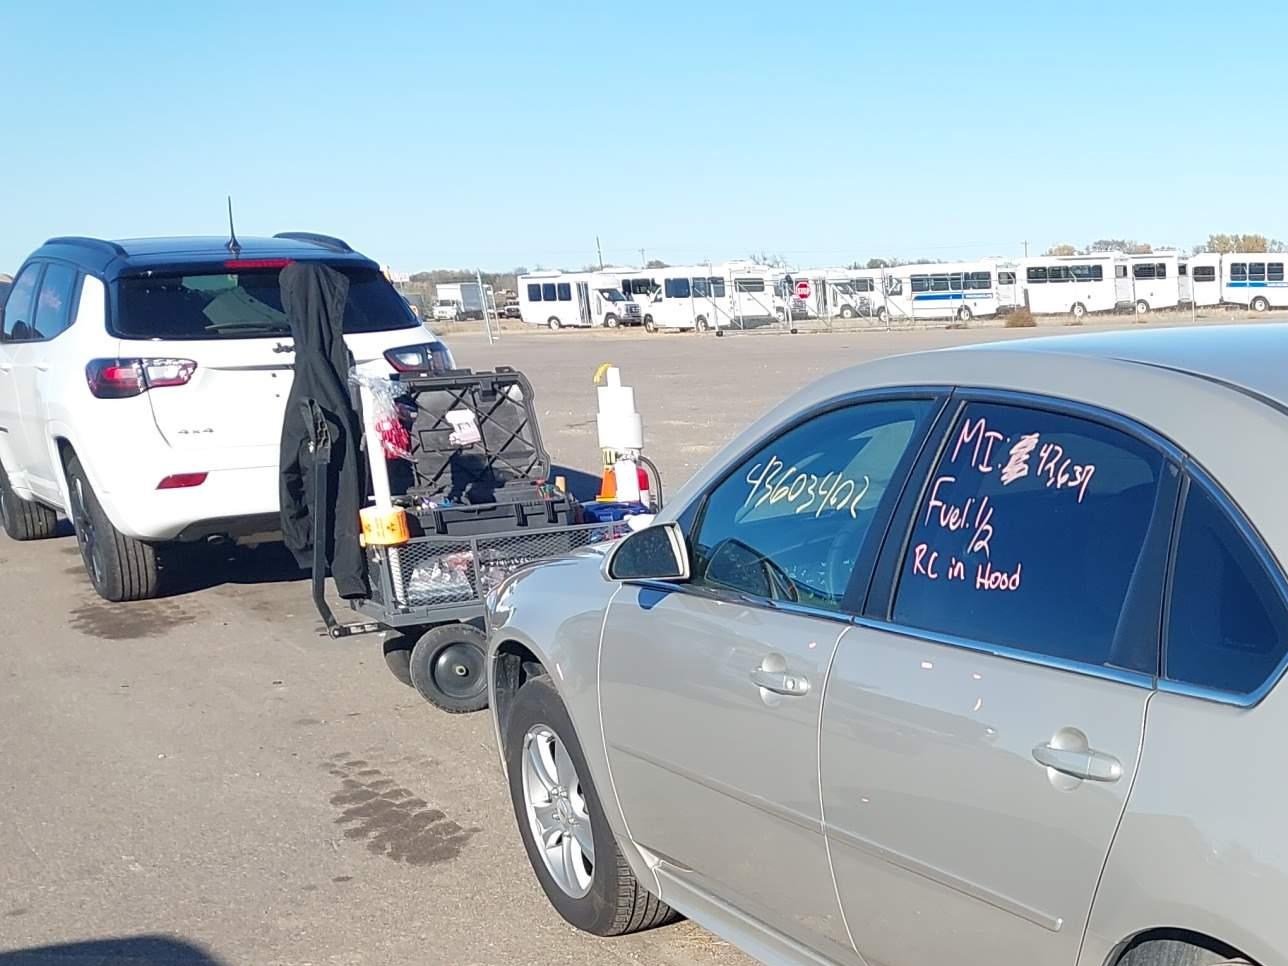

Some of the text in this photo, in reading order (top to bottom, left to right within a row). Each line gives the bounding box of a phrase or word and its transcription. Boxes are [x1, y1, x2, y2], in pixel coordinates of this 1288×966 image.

[743, 455, 870, 518] 43603402
[966, 496, 994, 560] 1/2
[913, 543, 1021, 590] RC in Hood
